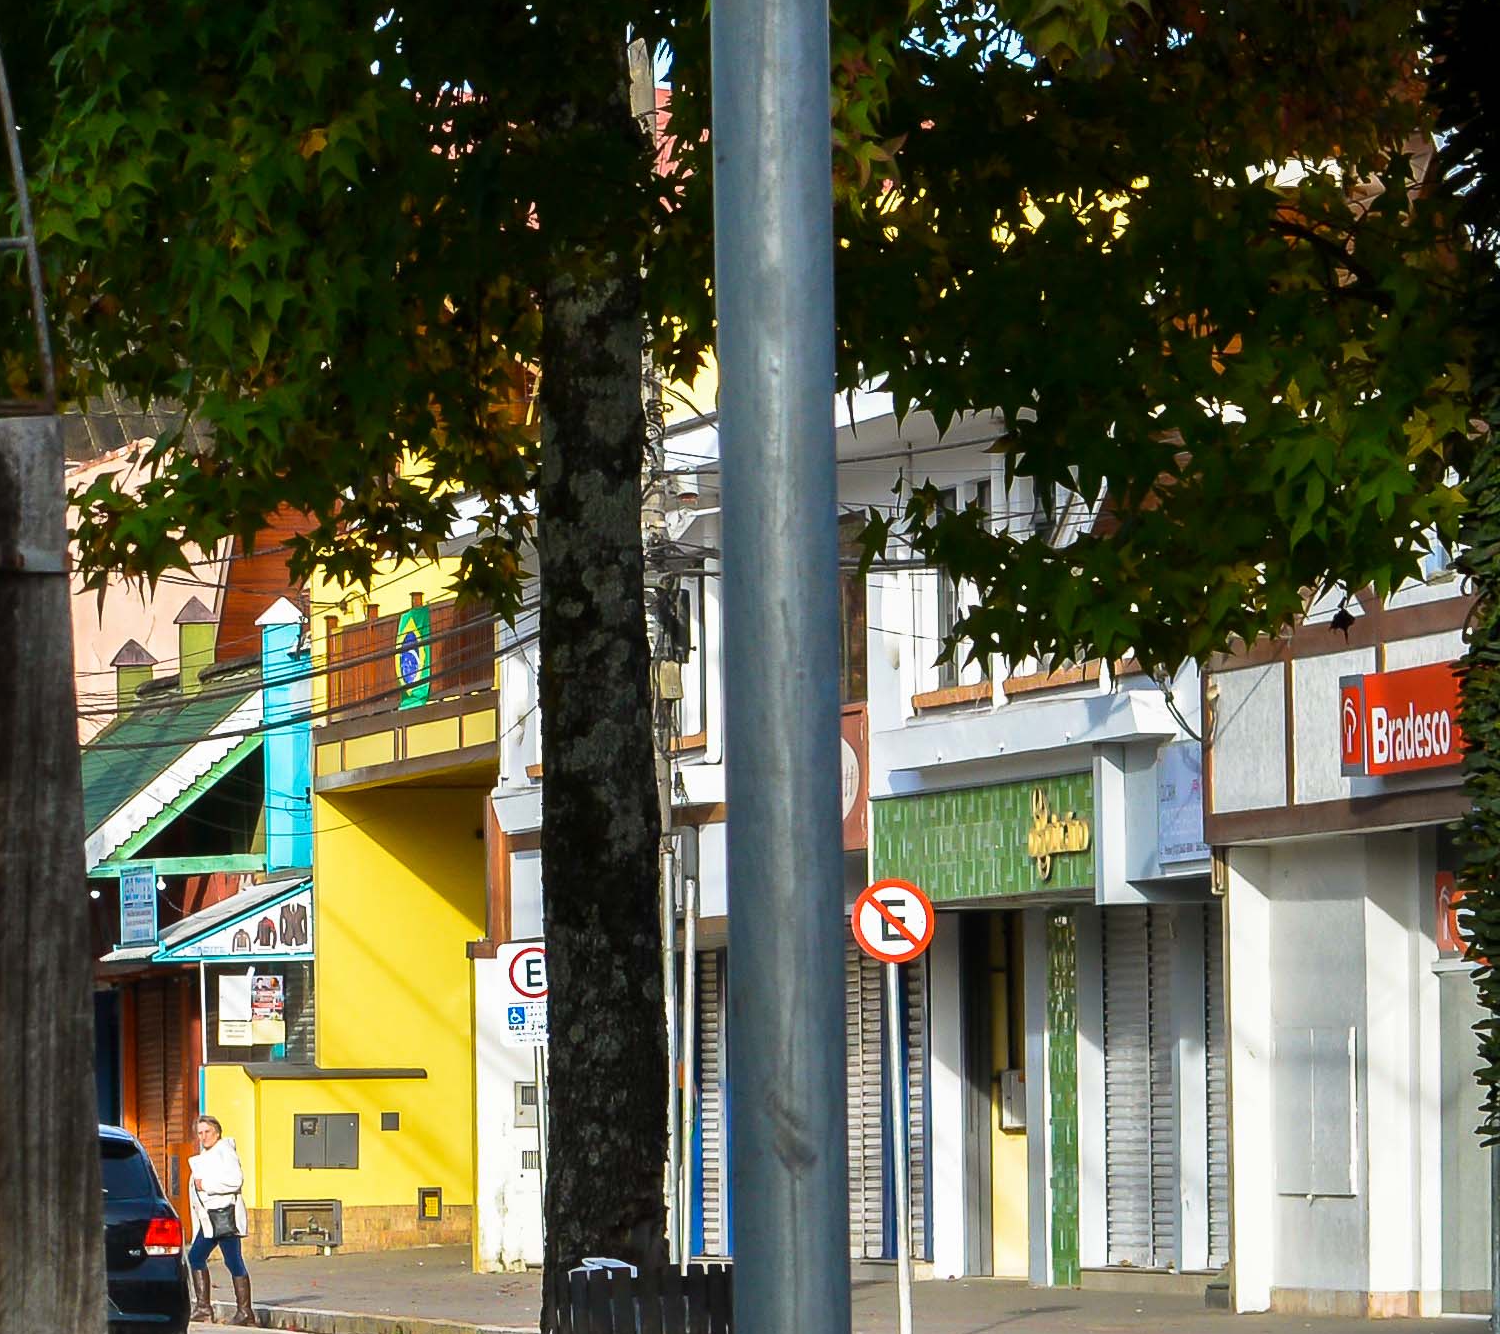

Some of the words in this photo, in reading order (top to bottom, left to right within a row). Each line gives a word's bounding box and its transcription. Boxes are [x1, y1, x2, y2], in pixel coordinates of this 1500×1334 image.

[1371, 701, 1451, 764] Bradesco
[881, 899, 908, 942] E
[526, 958, 543, 987] E
